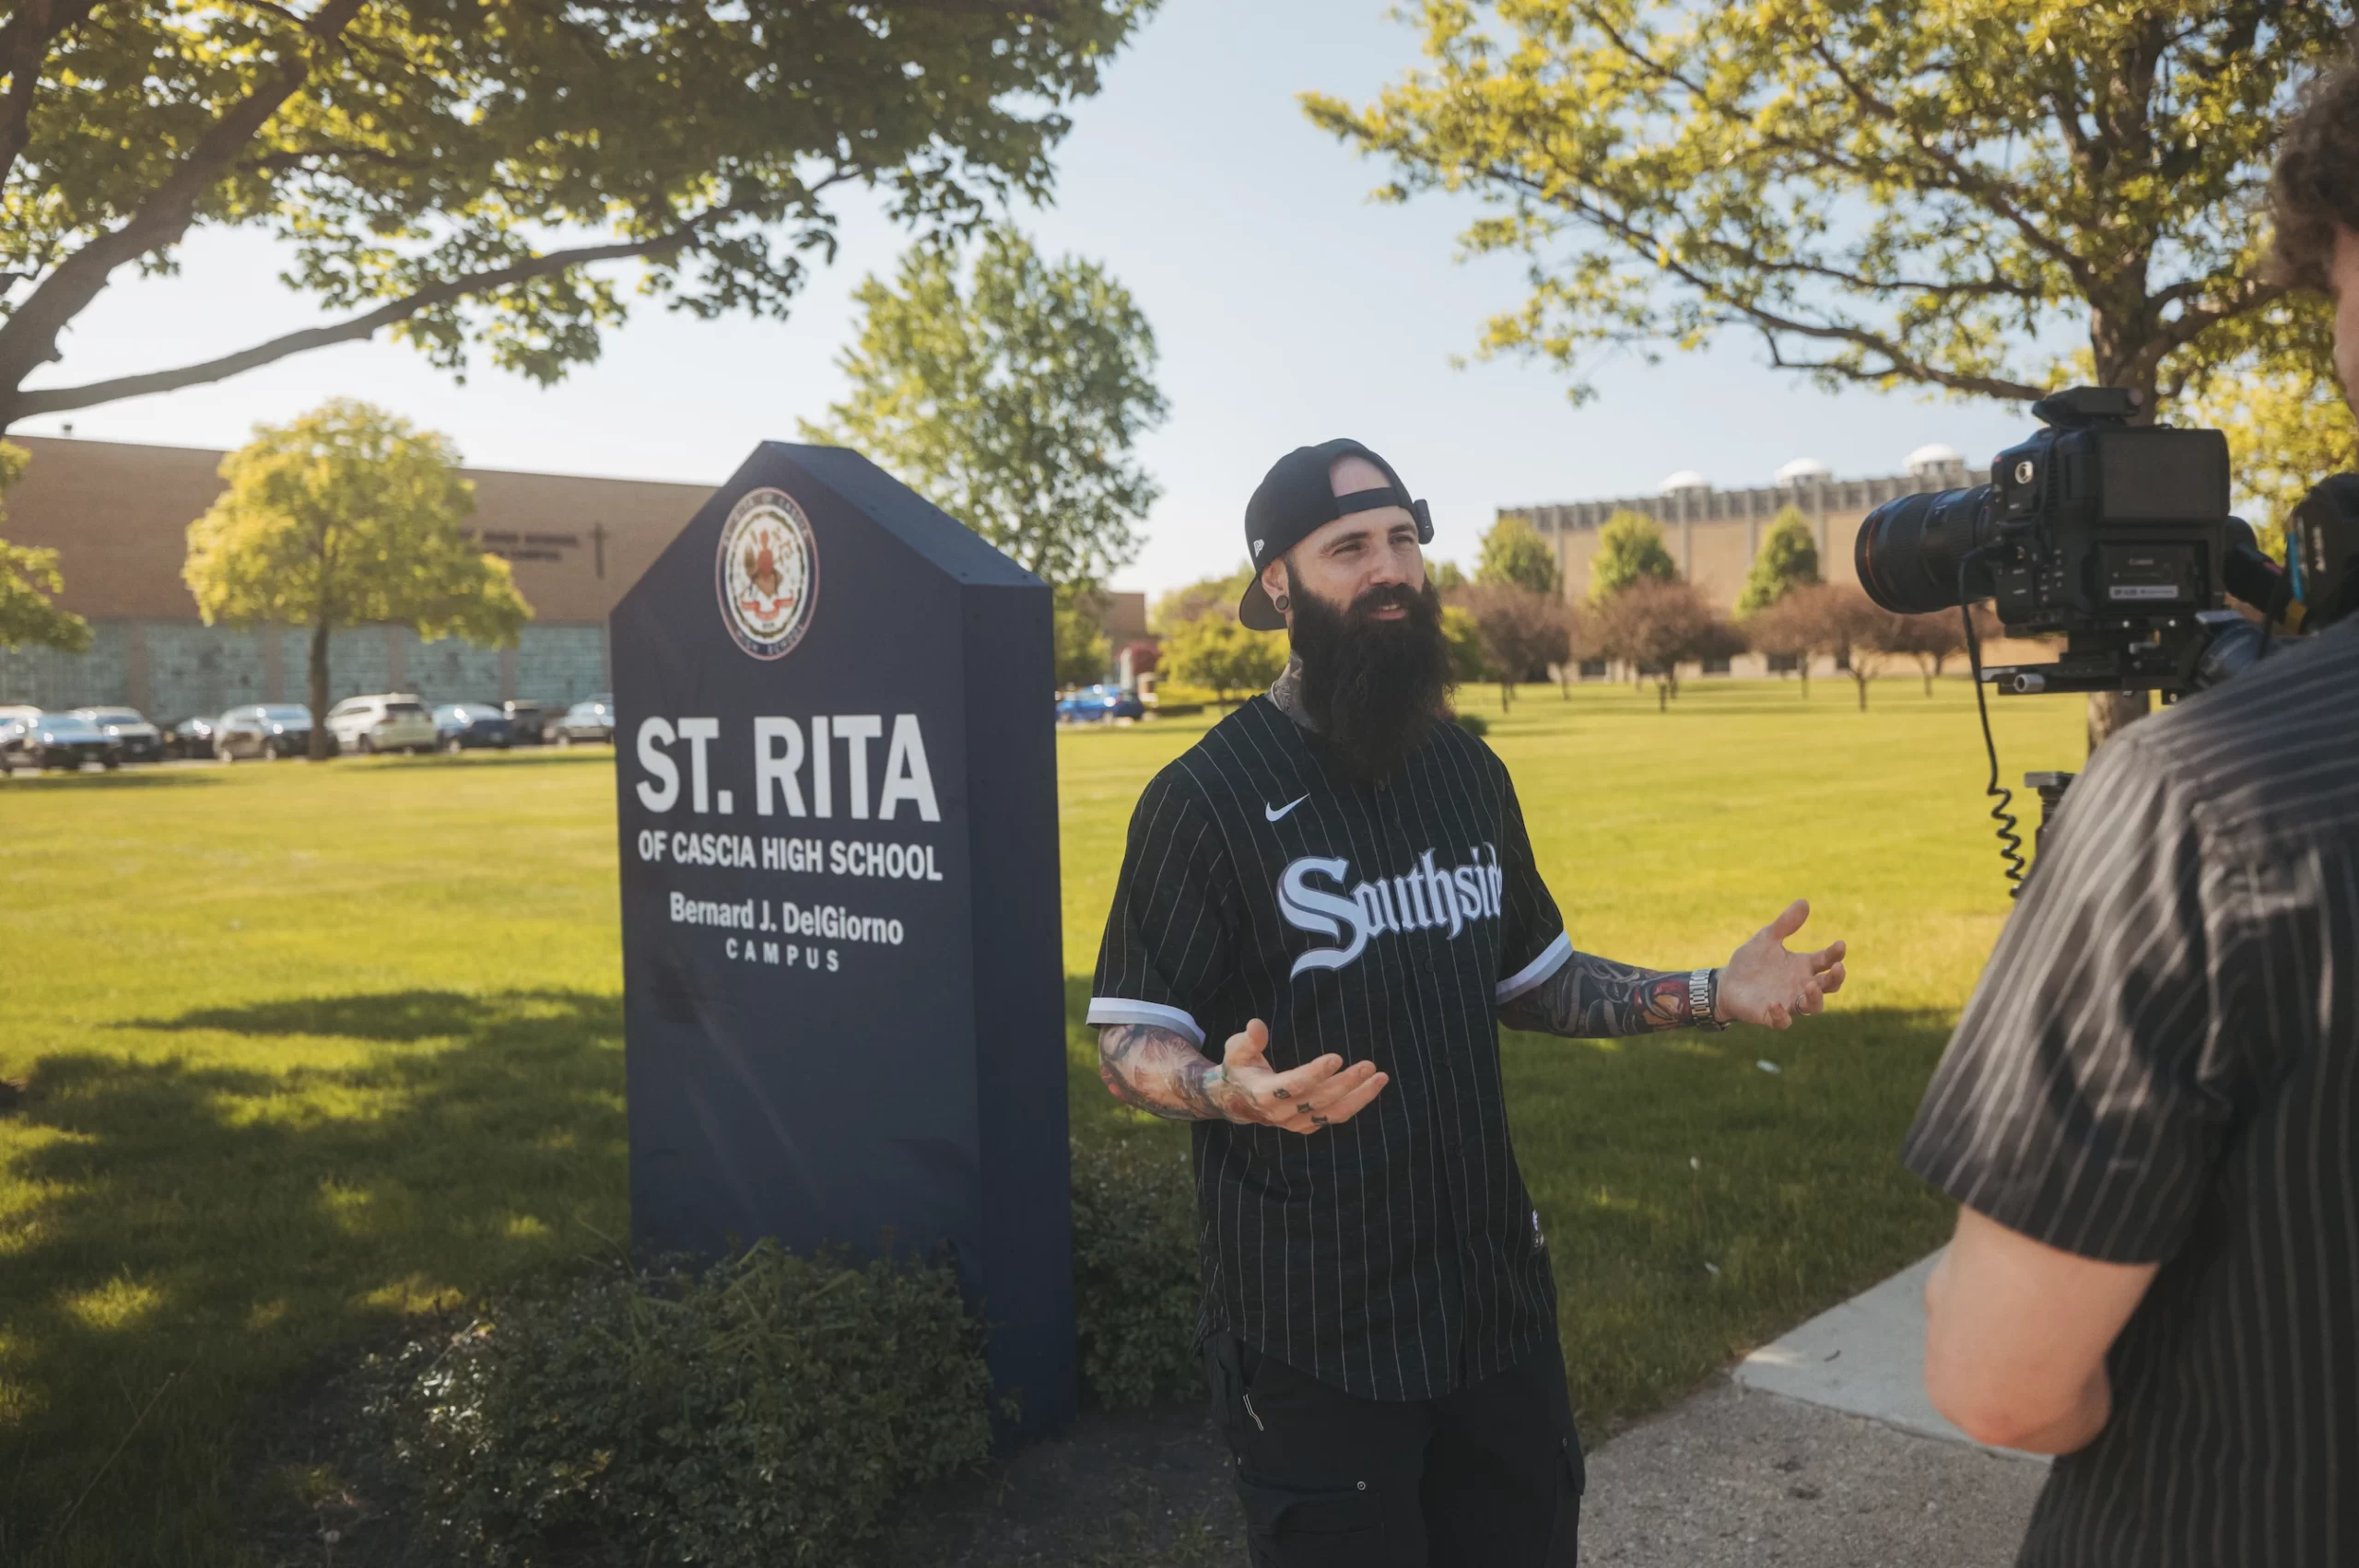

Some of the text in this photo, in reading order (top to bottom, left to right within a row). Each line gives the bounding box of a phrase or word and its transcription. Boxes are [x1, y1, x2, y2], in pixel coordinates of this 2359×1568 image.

[636, 713, 941, 823] ST. RITA
[638, 829, 944, 882] OF CASCIA HIGH SCHOOL
[670, 891, 904, 945] Bernard J. DelGiorno
[1277, 841, 1503, 982] Southsid
